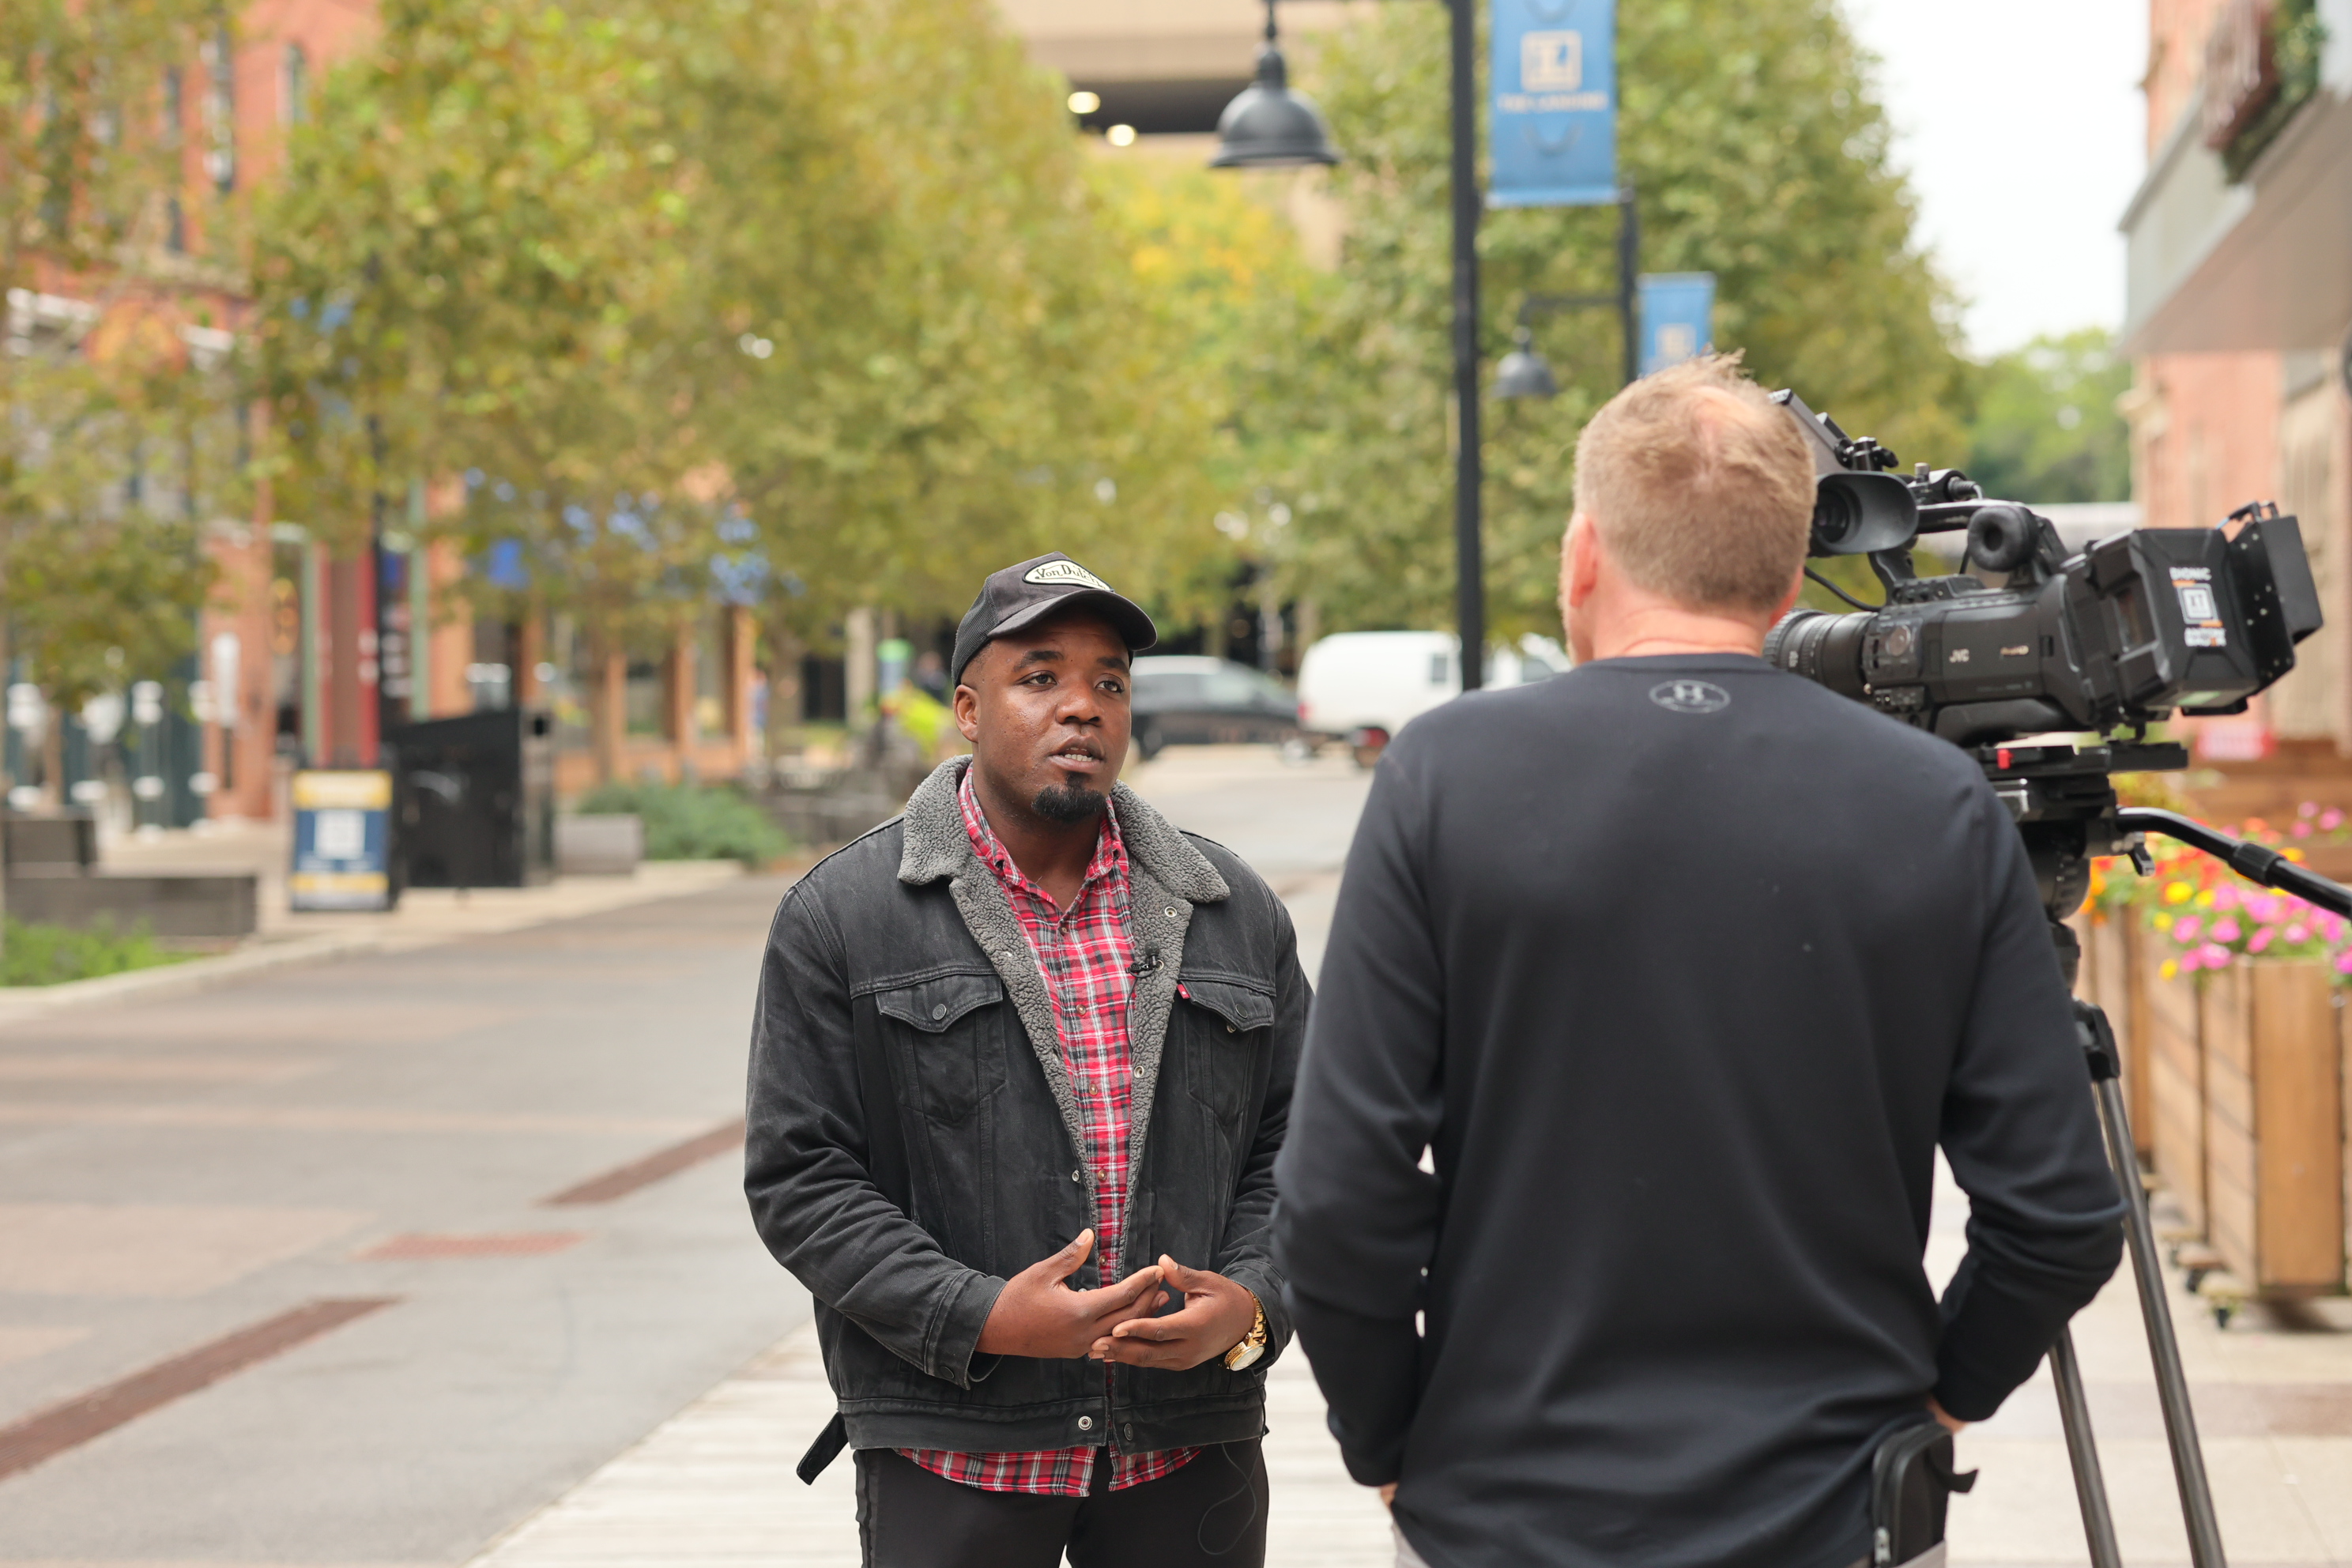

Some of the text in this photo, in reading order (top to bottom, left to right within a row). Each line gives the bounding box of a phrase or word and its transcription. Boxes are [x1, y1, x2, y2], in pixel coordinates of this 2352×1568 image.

[1035, 564, 1100, 588] Von Dutch
[1949, 649, 1969, 663] JVC
